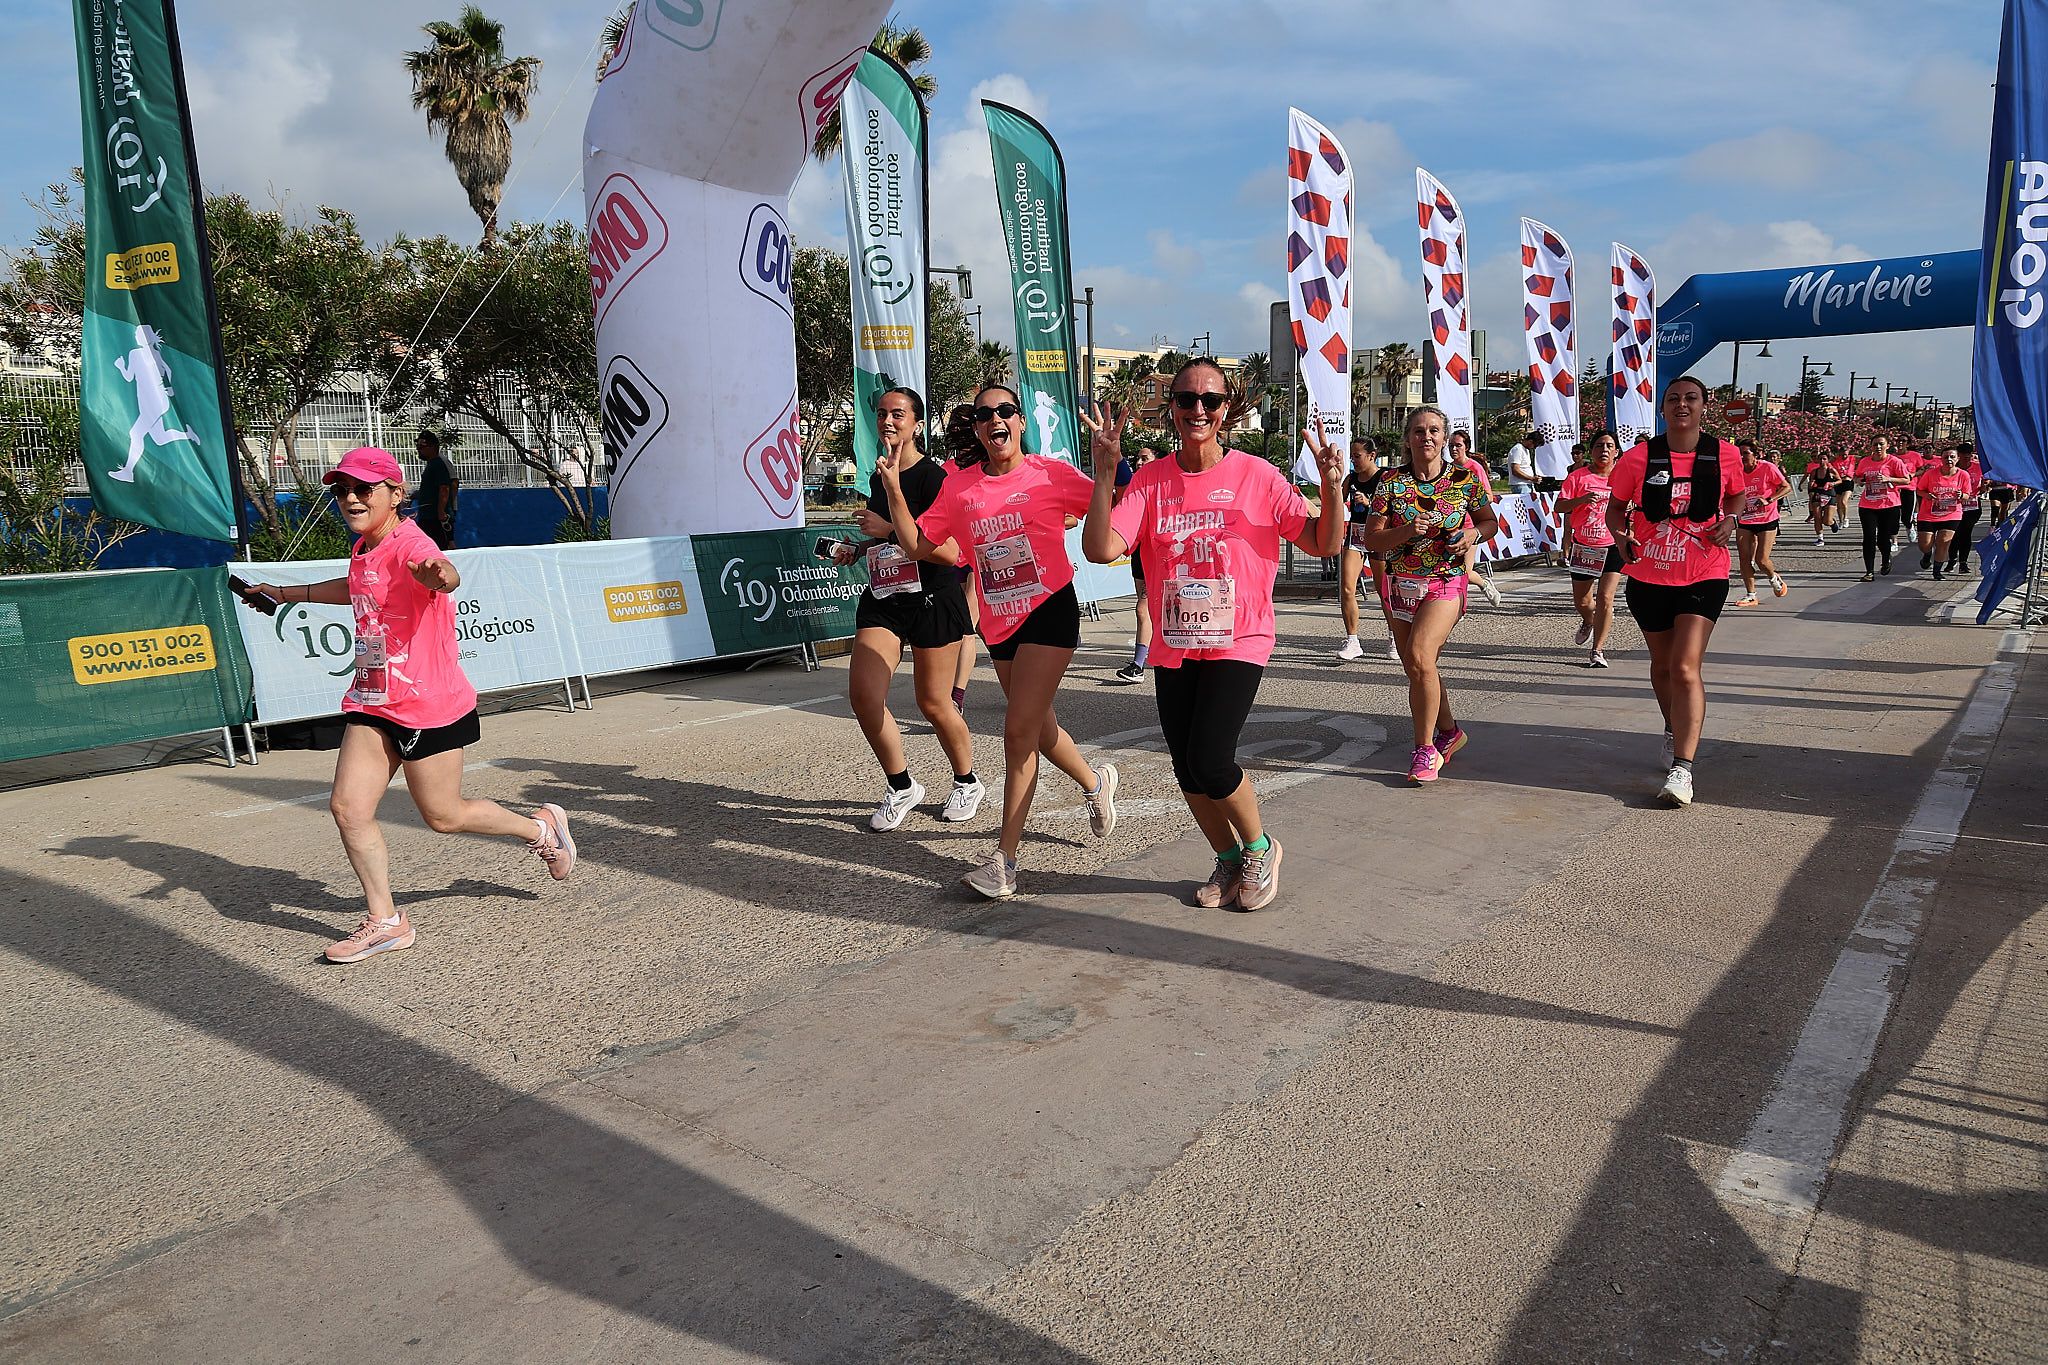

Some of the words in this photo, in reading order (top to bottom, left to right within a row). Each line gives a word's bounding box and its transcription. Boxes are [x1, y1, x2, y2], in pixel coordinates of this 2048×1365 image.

[590, 192, 649, 318] SMO
[757, 221, 793, 306] CO
[1783, 265, 1933, 326] Marlene
[602, 373, 651, 476] SMO
[970, 511, 1025, 538] CARRERA
[1157, 510, 1225, 535] CARRERA
[1581, 526, 1606, 538] MUJER
[1194, 536, 1214, 563] DE
[1643, 544, 1687, 562] MUJER
[776, 565, 839, 583] Institutos
[880, 566, 899, 578] 016
[993, 567, 1016, 581] 016
[1654, 561, 1670, 570] 2026
[609, 591, 635, 604] 900
[636, 589, 655, 602] 131
[657, 586, 680, 600] 002
[613, 600, 682, 618] www.ioa.es
[808, 604, 840, 616] dentales
[1181, 611, 1210, 623] 016
[455, 616, 535, 643] ológicos
[79, 642, 123, 660] 900
[128, 637, 159, 654] 131
[164, 633, 204, 650] 002
[83, 651, 207, 676] www.ioa.es
